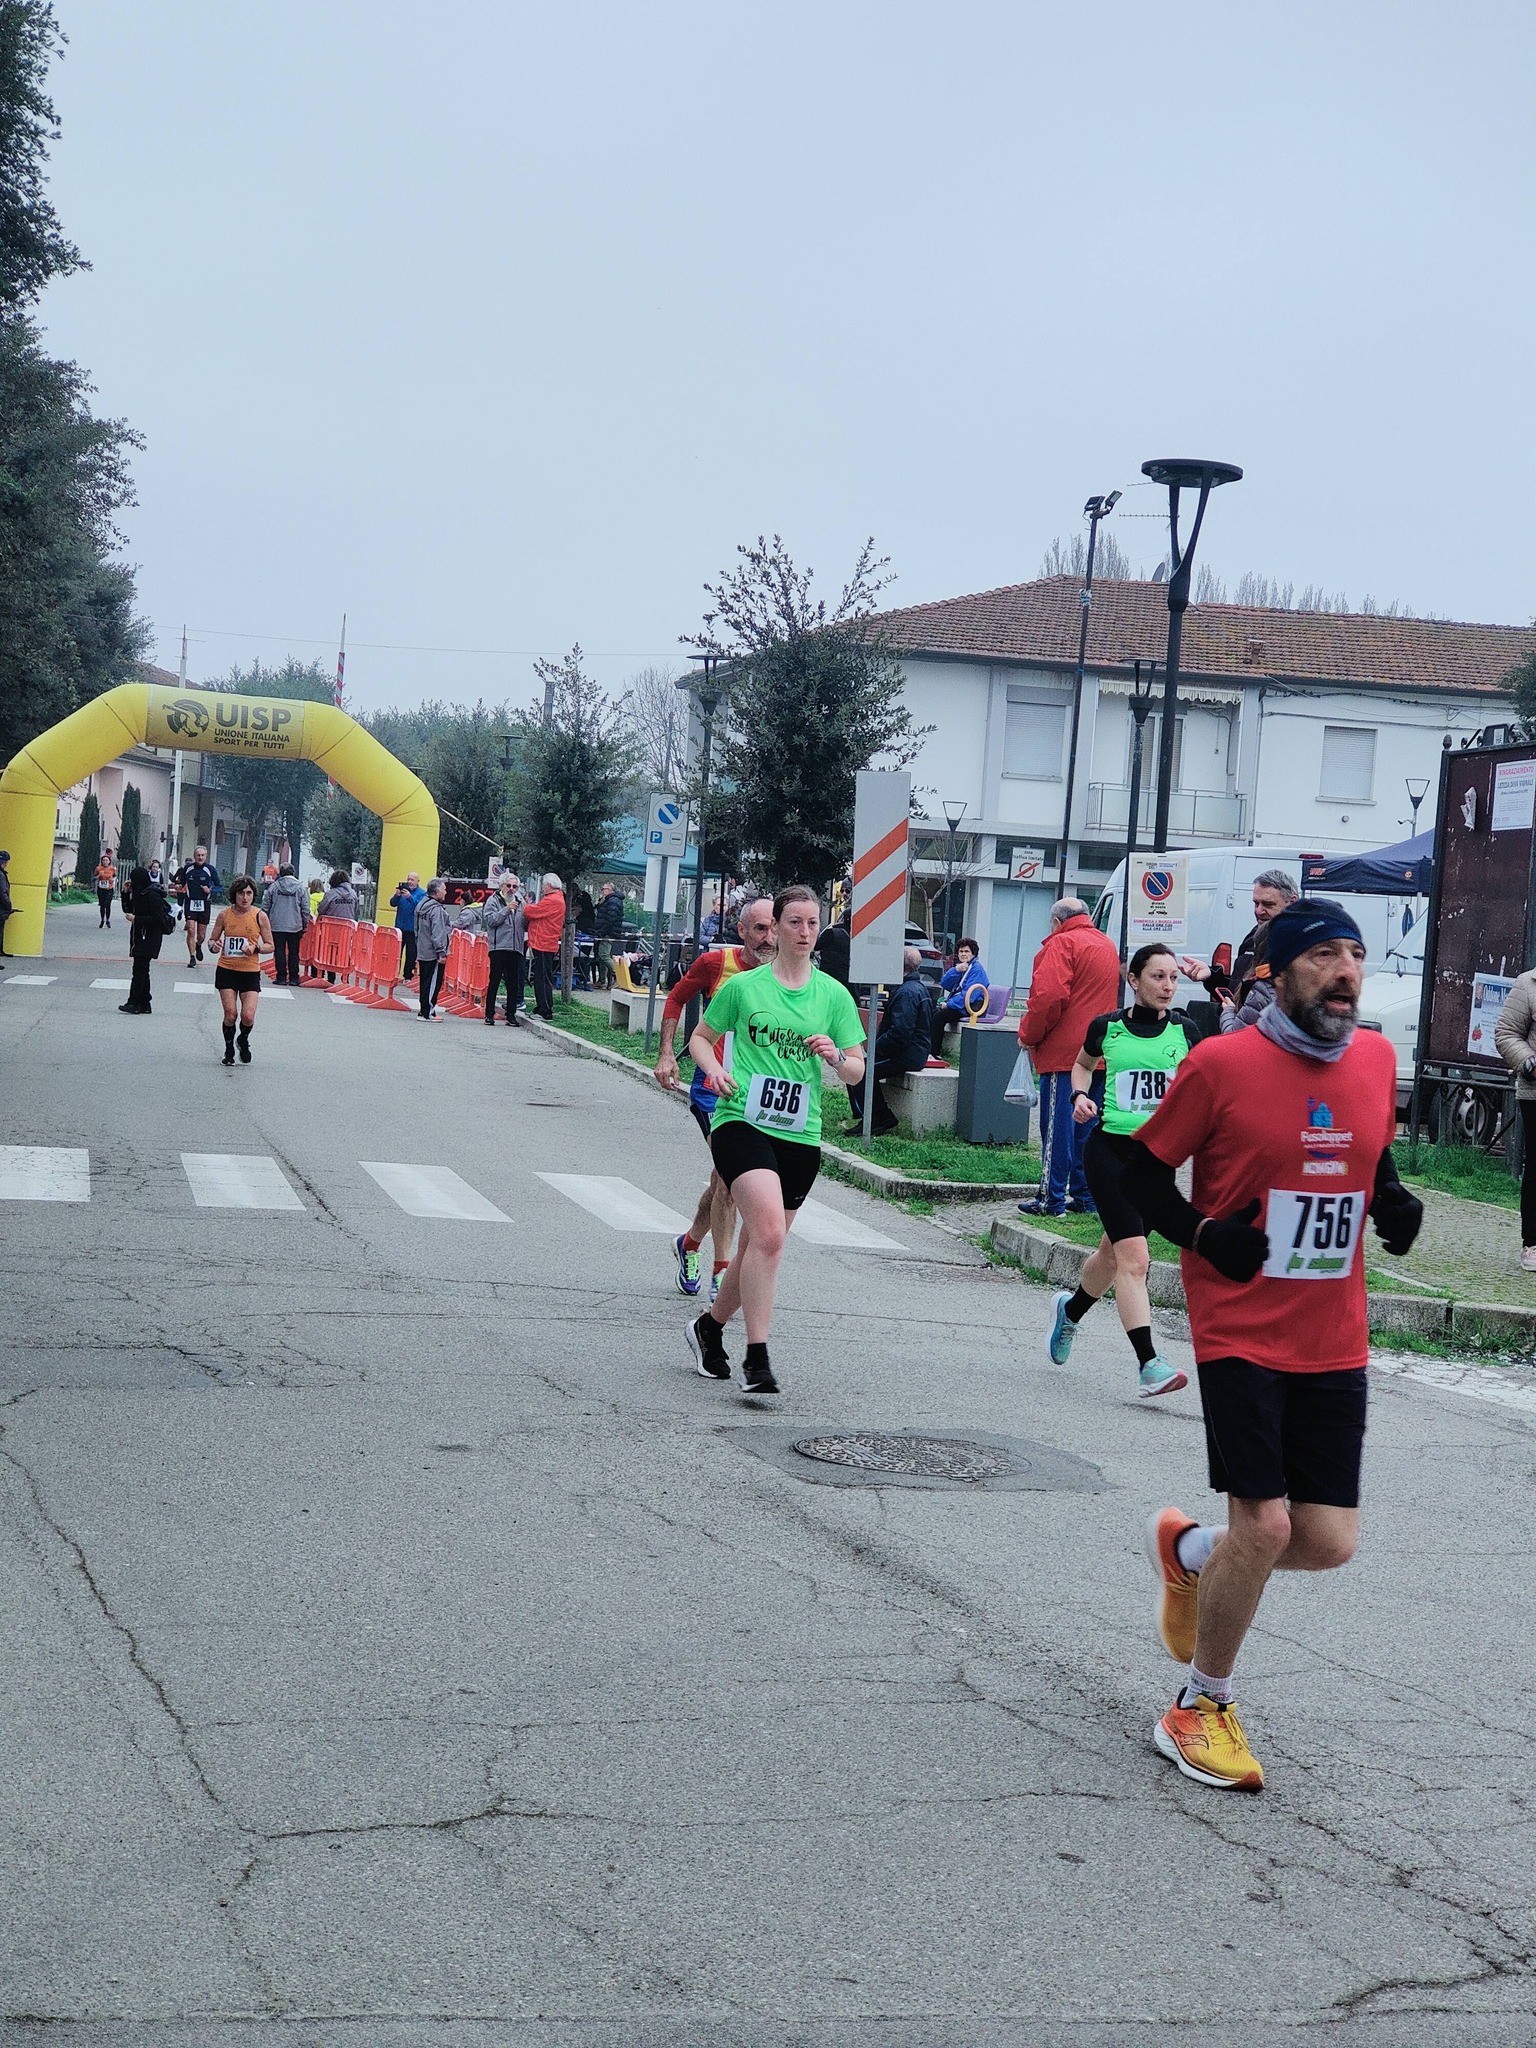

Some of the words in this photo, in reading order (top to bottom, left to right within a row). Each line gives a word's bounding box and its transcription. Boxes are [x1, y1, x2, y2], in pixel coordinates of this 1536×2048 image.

[216, 702, 292, 732] UISP
[213, 736, 240, 746] SPORT
[243, 740, 259, 748] PER
[263, 741, 285, 750] TUTTI
[214, 728, 248, 739] UNIONE
[251, 731, 290, 743] ITALIANA
[652, 832, 661, 842] P
[229, 937, 245, 951] 612
[760, 1077, 803, 1115] 636
[1129, 1070, 1166, 1100] 738
[1292, 1195, 1354, 1250] 756
